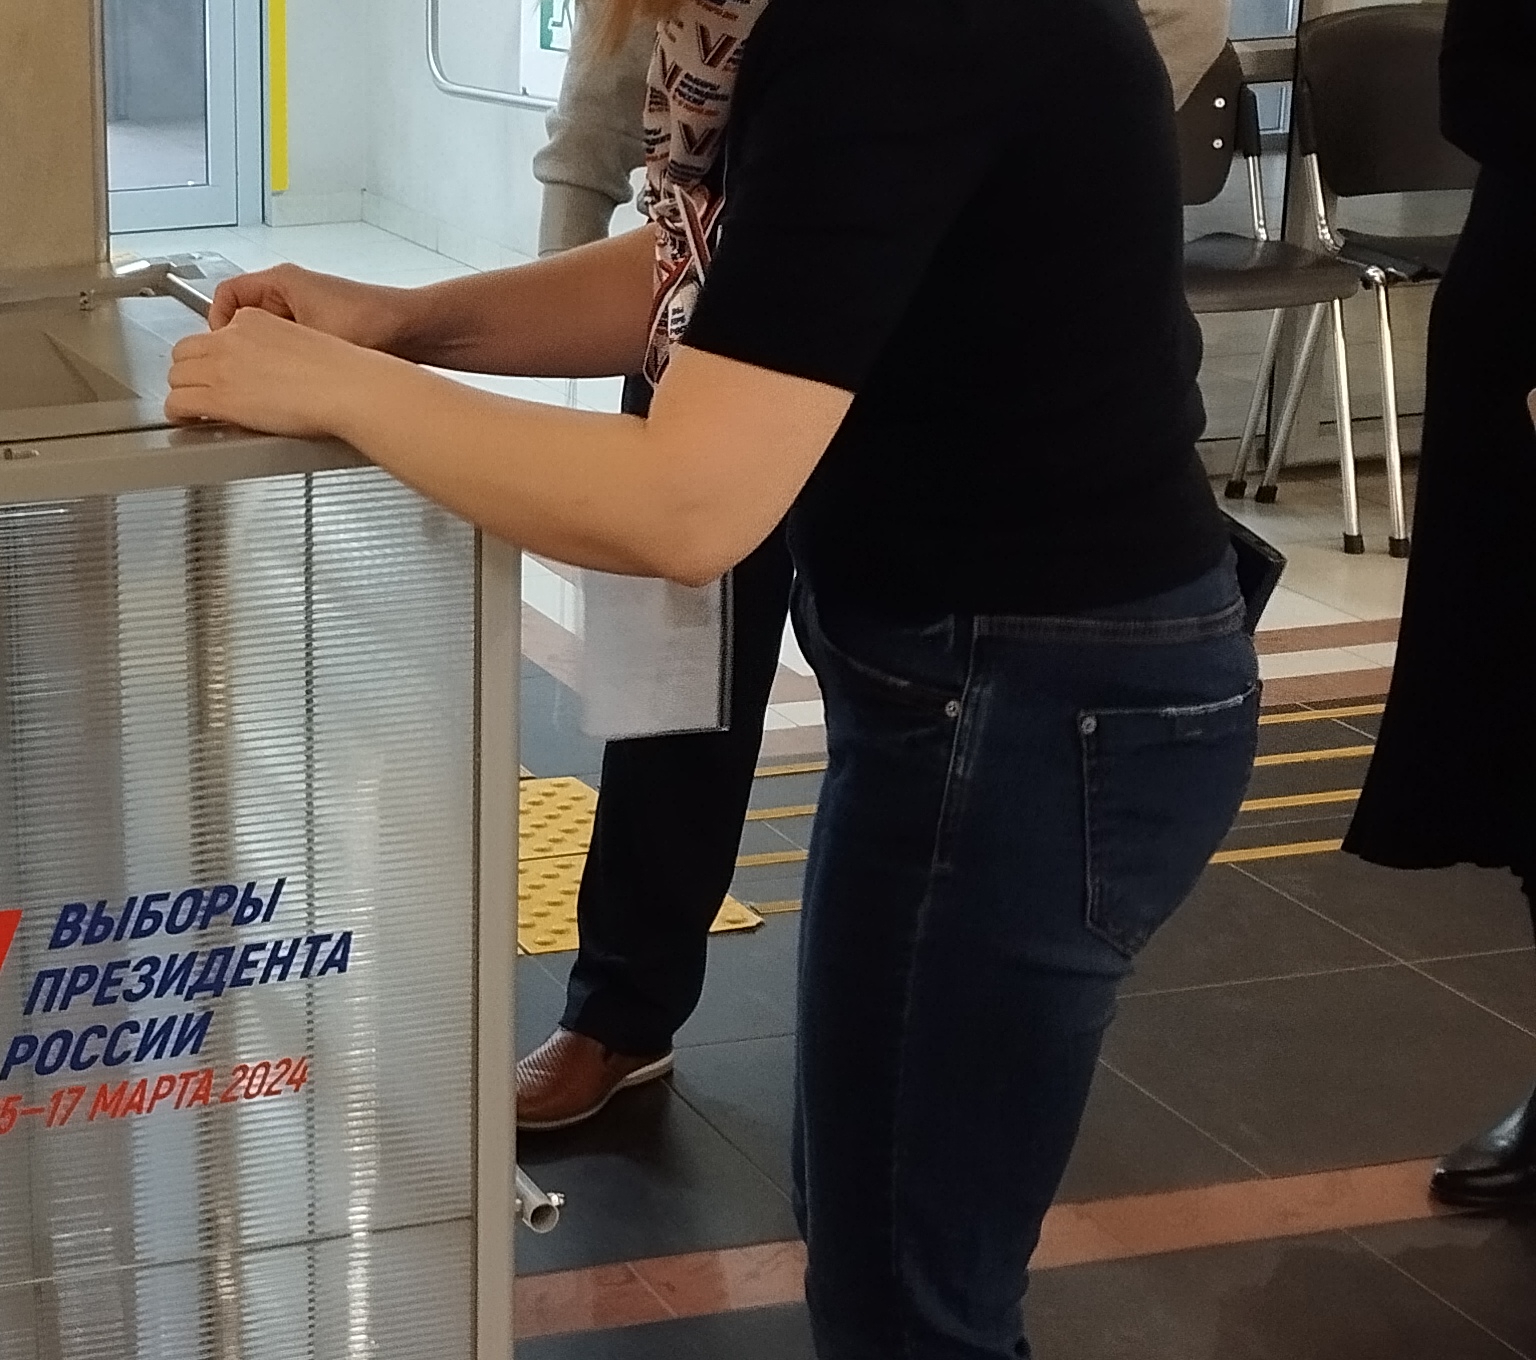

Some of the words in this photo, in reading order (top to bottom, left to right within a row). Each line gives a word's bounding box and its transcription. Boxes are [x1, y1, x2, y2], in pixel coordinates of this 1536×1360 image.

[48, 877, 287, 951] ВЫБОРЫ
[22, 930, 354, 1017] ПРЕЗИДЕНТА
[87, 1067, 216, 1124] МАРТА
[218, 1056, 310, 1105] 2024
